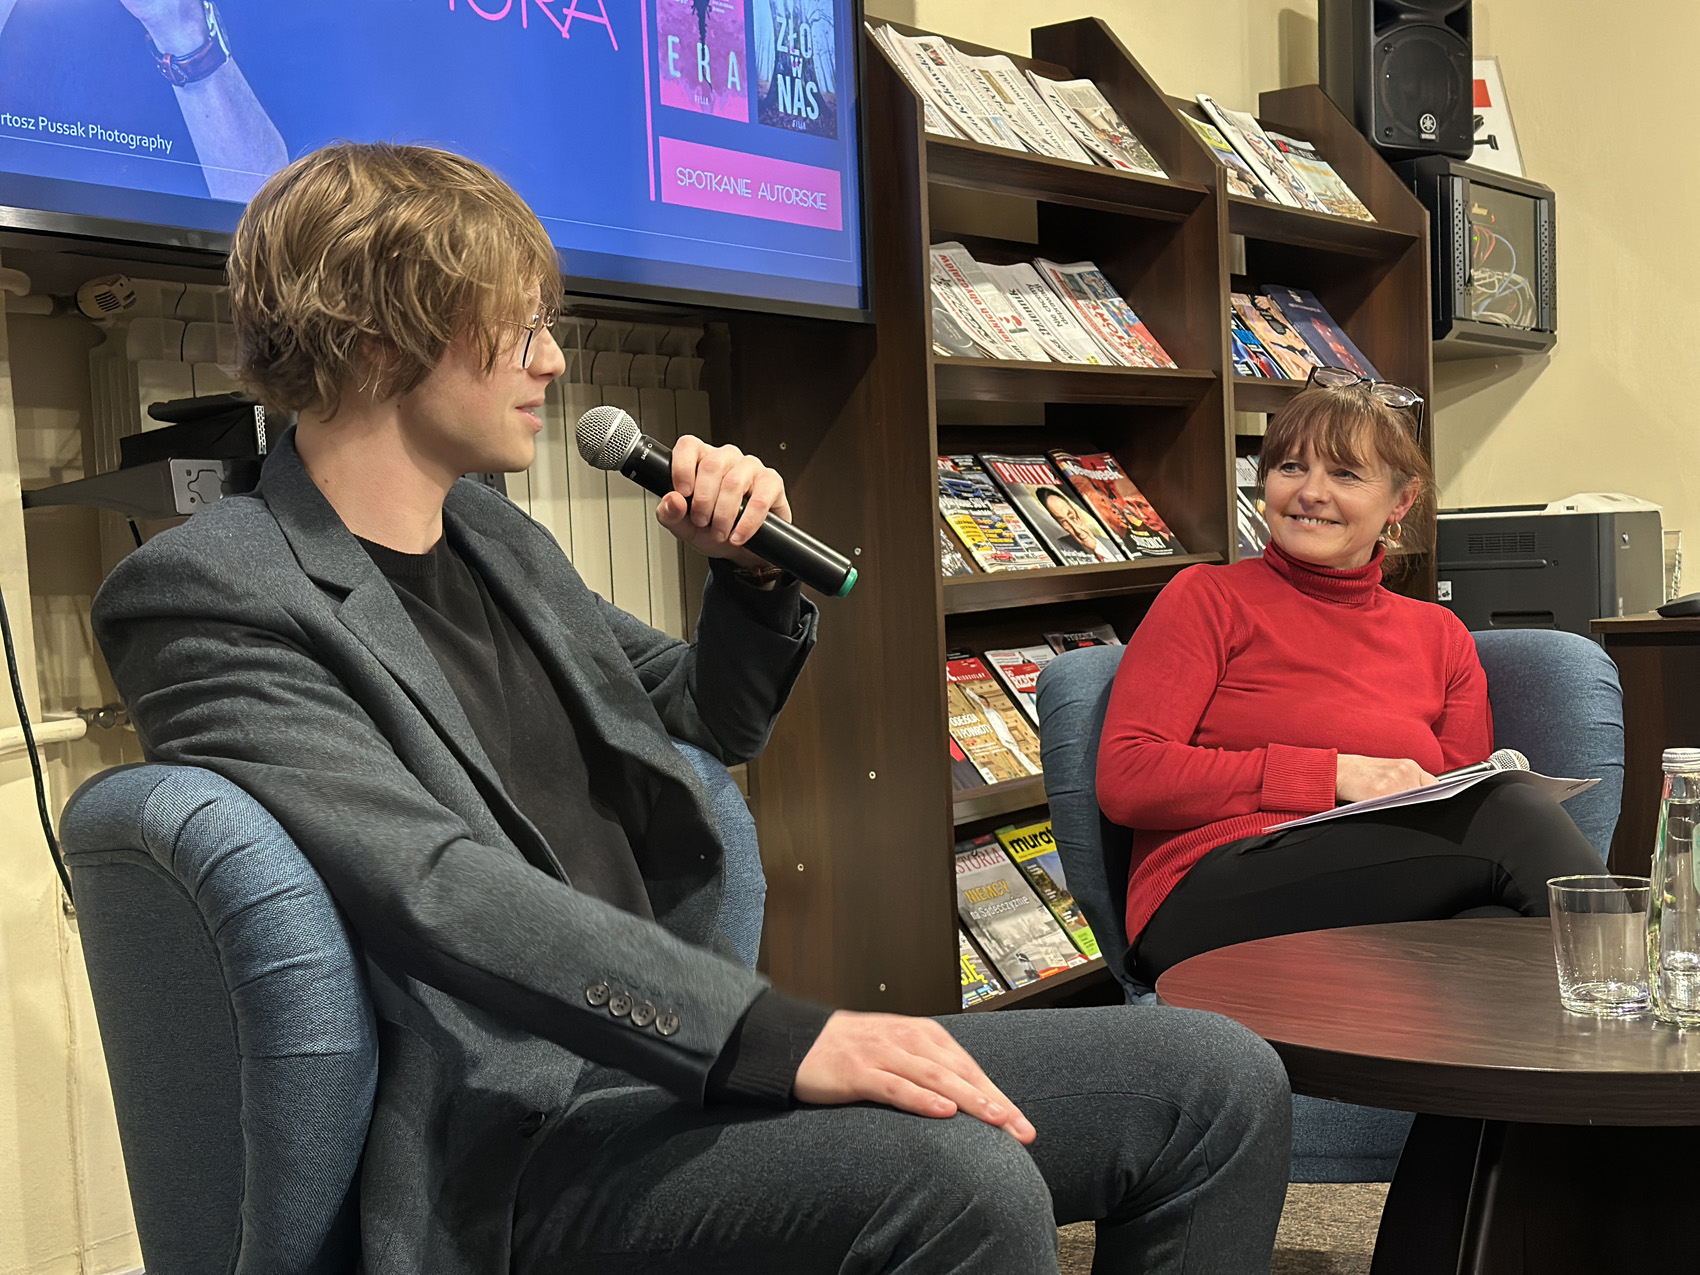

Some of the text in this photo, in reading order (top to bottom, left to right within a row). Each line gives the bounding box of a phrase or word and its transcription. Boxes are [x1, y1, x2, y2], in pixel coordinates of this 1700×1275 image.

[776, 16, 813, 59] ZŁO
[667, 35, 741, 91] ERA
[915, 53, 968, 115] Krakowska
[777, 74, 820, 120] NAS
[1023, 101, 1044, 127] kontra
[0, 112, 173, 154] rtosz Pussak Photography
[676, 167, 827, 211] SPOTKANIE AUTORSKIE
[938, 254, 983, 306] obyczajów
[980, 307, 1013, 343] lekkich
[1008, 287, 1053, 336] Dziennik
[1026, 283, 1063, 328] Nie chcemy
[1034, 283, 1069, 325] deprawacji
[994, 462, 1060, 485] POLITYKA
[959, 724, 993, 739] POWROTY
[955, 847, 1006, 875] STORIA
[964, 880, 1010, 904] NIEMCY
[970, 911, 981, 921] na
[979, 895, 1031, 919] Sądecczyźnie
